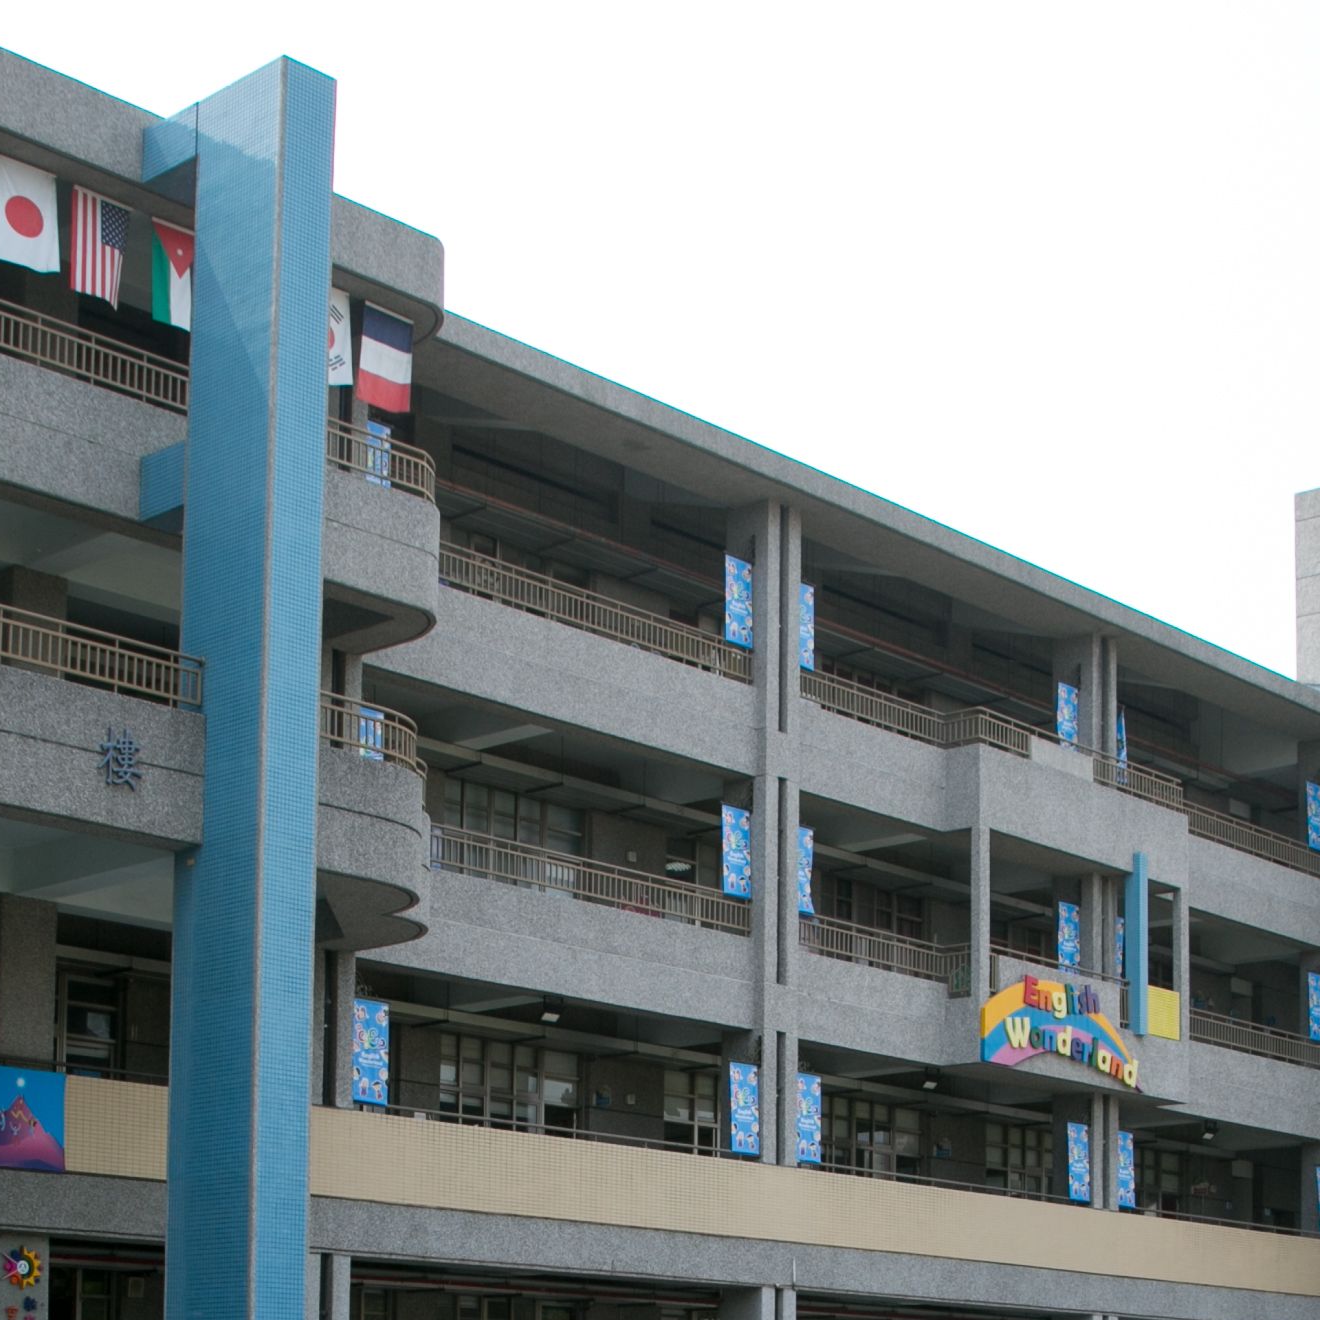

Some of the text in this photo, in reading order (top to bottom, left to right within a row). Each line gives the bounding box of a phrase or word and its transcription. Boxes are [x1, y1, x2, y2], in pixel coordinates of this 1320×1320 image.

[97, 726, 144, 792] 樓
[1023, 974, 1101, 1019] English
[1004, 1016, 1139, 1089] Wonderland
